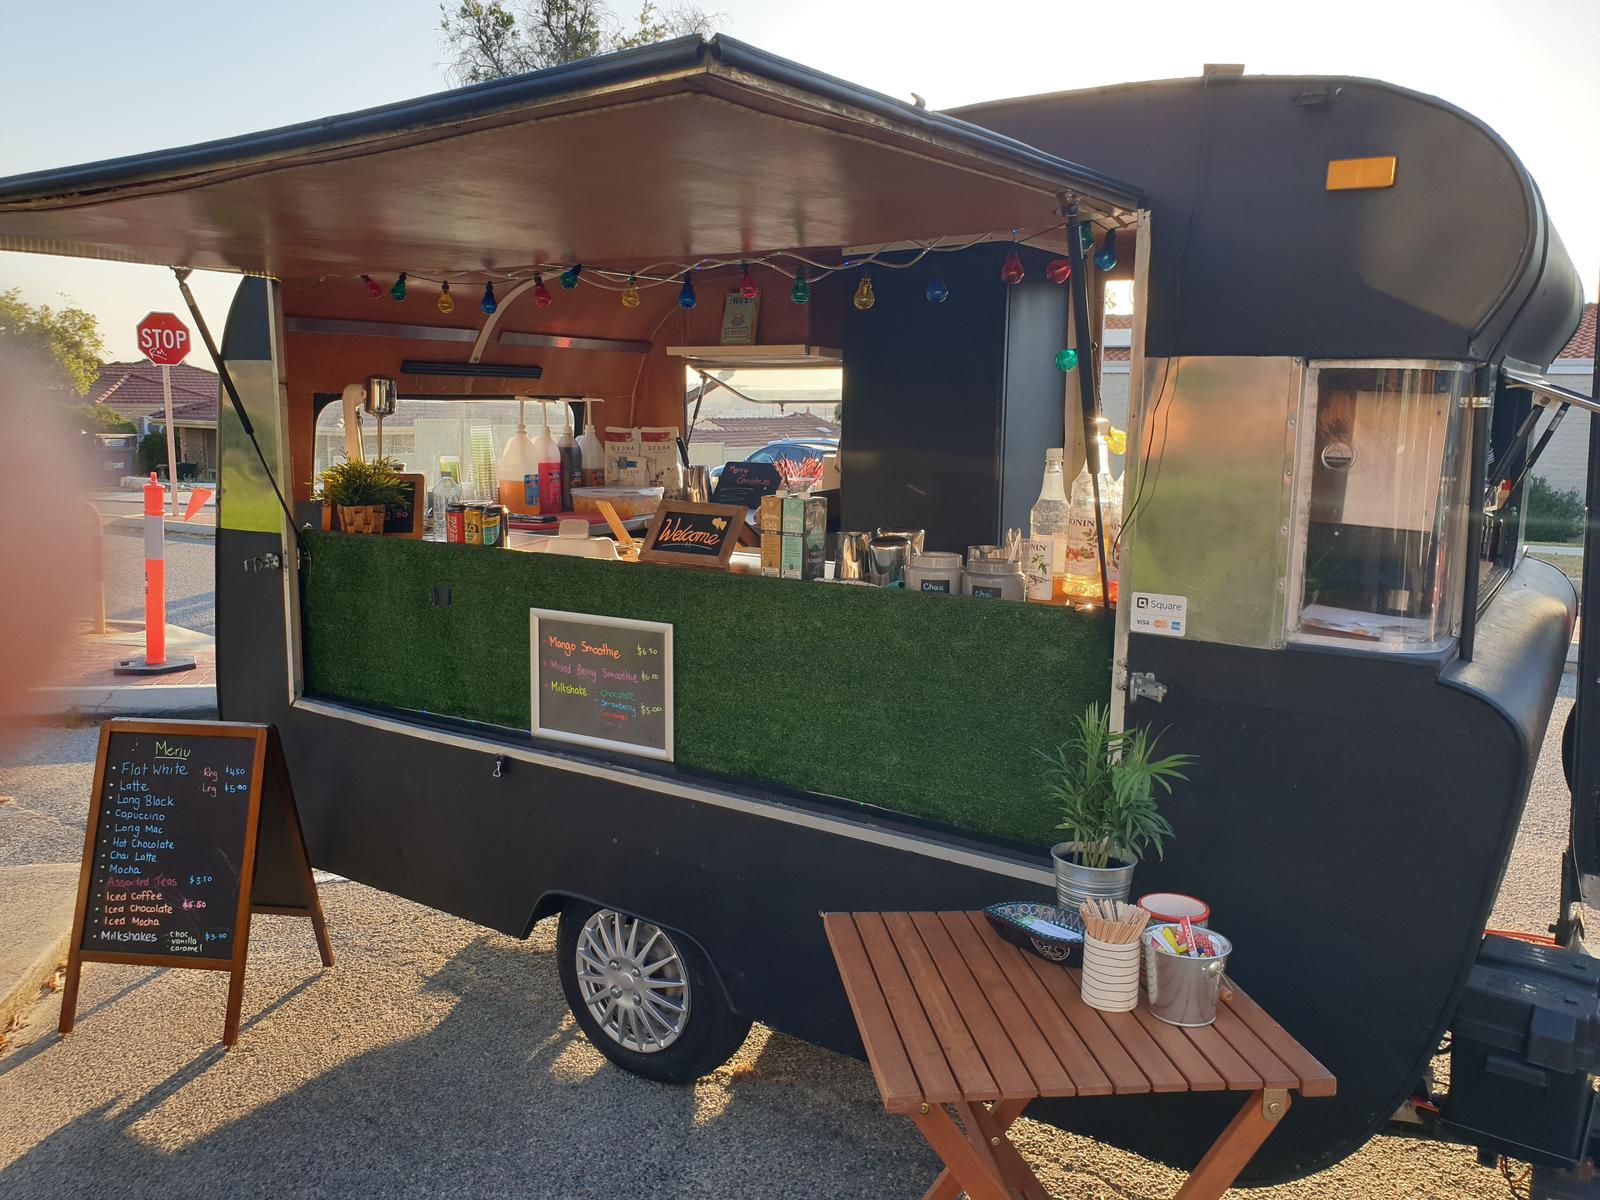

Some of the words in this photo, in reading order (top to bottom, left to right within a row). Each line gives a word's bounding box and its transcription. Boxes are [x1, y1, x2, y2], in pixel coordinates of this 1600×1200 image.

[141, 328, 187, 349] STOP
[659, 518, 721, 545] Welcome
[1150, 600, 1182, 610] Square
[549, 636, 576, 656] Mango
[581, 641, 621, 659] Smoothie
[551, 660, 572, 674] Mixed
[576, 663, 597, 682] Berry
[601, 667, 639, 683] Smoothie
[551, 681, 588, 697] Milkshake
[601, 700, 637, 718] Strawberry
[640, 703, 662, 715] $5.00
[155, 740, 191, 756] Menu
[121, 762, 148, 775] Flat
[152, 762, 189, 775] White
[203, 766, 218, 782] Reg
[120, 780, 149, 791] Latte
[202, 782, 217, 798] Lrg
[224, 782, 248, 793] $5.00
[117, 793, 140, 810] Long
[144, 795, 174, 807] Black
[115, 809, 166, 821] Capuccino
[115, 824, 140, 838] Long
[145, 825, 163, 833] Mac
[113, 837, 127, 848] Hot
[131, 839, 175, 849] Chocolate
[110, 850, 129, 860] Chai
[135, 851, 157, 863] Latte
[109, 864, 142, 875] Mocha
[154, 875, 178, 886] Teas
[106, 892, 127, 901] Iced
[131, 890, 163, 901] Coffee
[105, 905, 124, 914] Iced
[129, 903, 174, 915] Chocolate
[104, 916, 126, 926] Iced
[131, 916, 160, 927] Mocha
[101, 931, 158, 942] Milkshakes
[171, 936, 197, 945] vanilla
[170, 944, 203, 952] caramel
